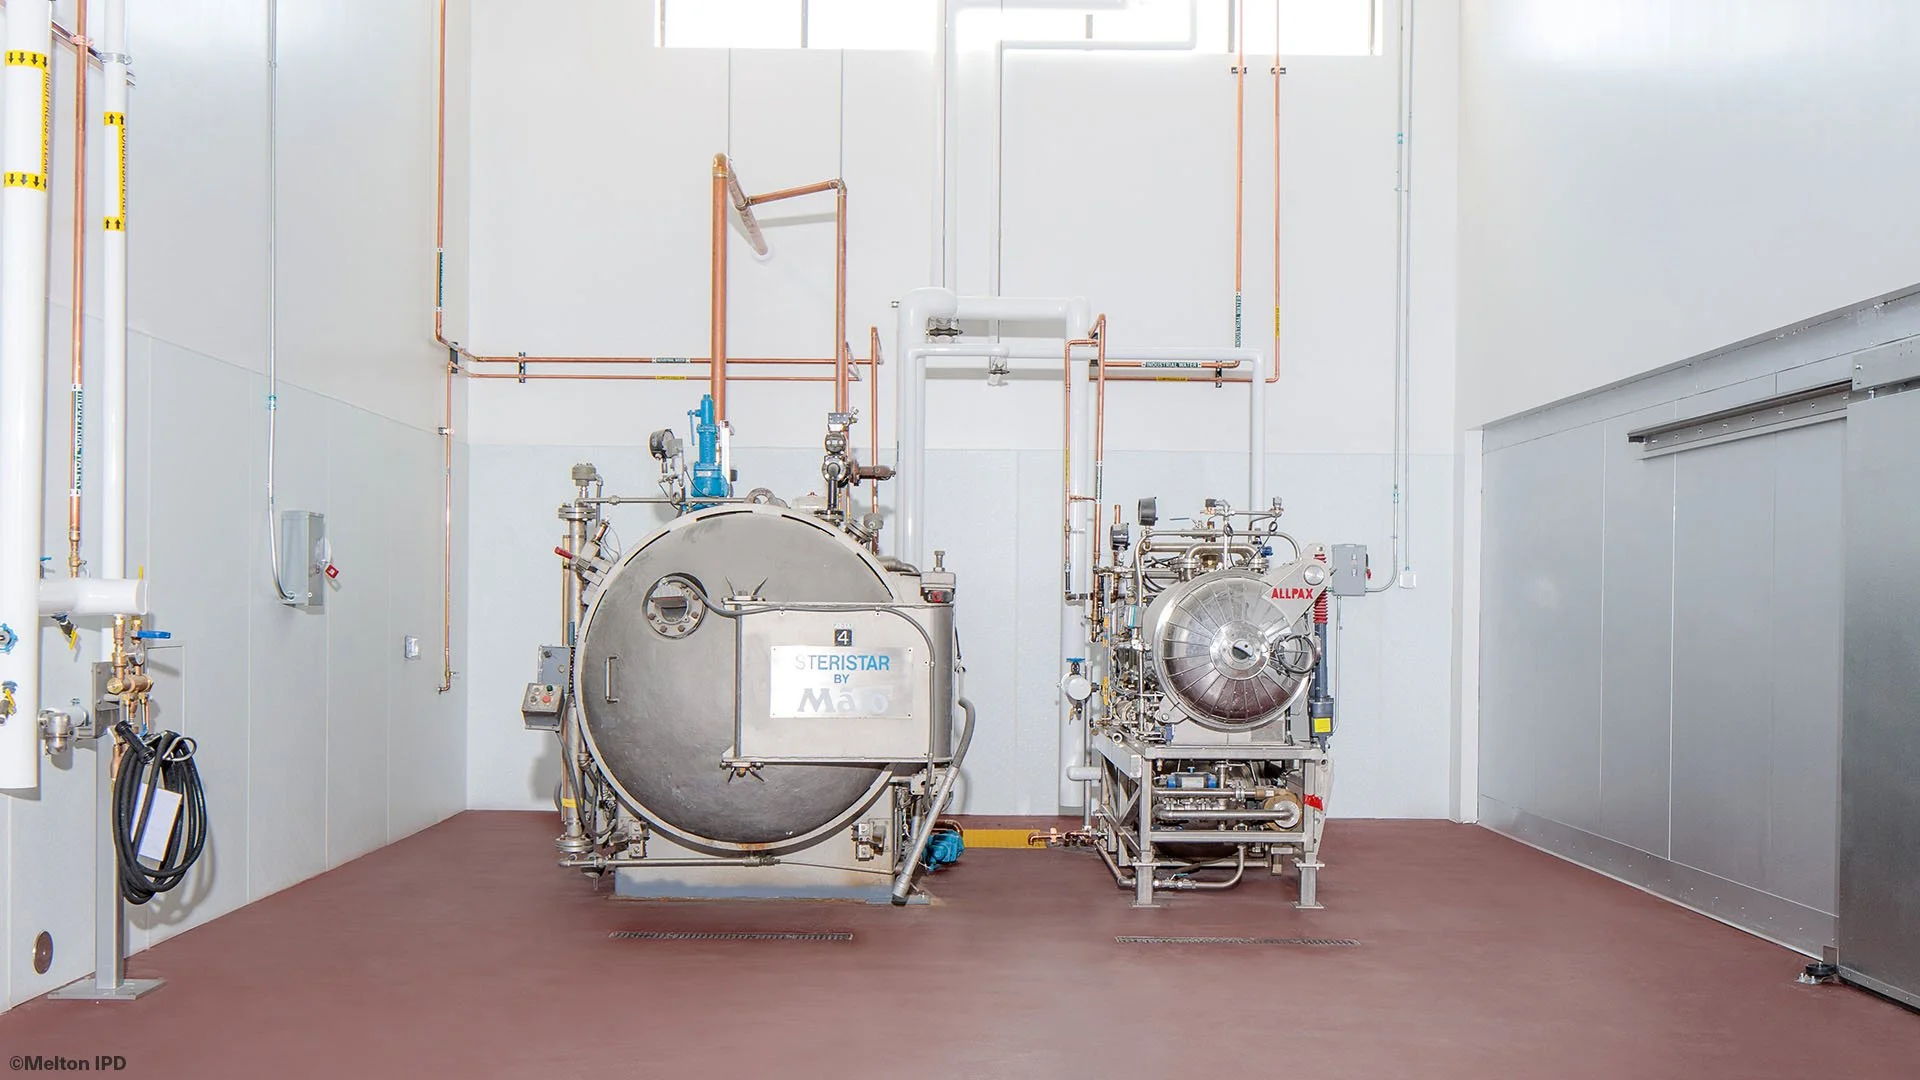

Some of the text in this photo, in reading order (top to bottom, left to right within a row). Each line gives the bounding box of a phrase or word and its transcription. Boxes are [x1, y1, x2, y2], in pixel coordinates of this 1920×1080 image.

[1271, 588, 1314, 599] ALLPAX
[837, 630, 849, 645] 4
[795, 655, 890, 671] STERISTAR
[834, 674, 850, 684] BY
